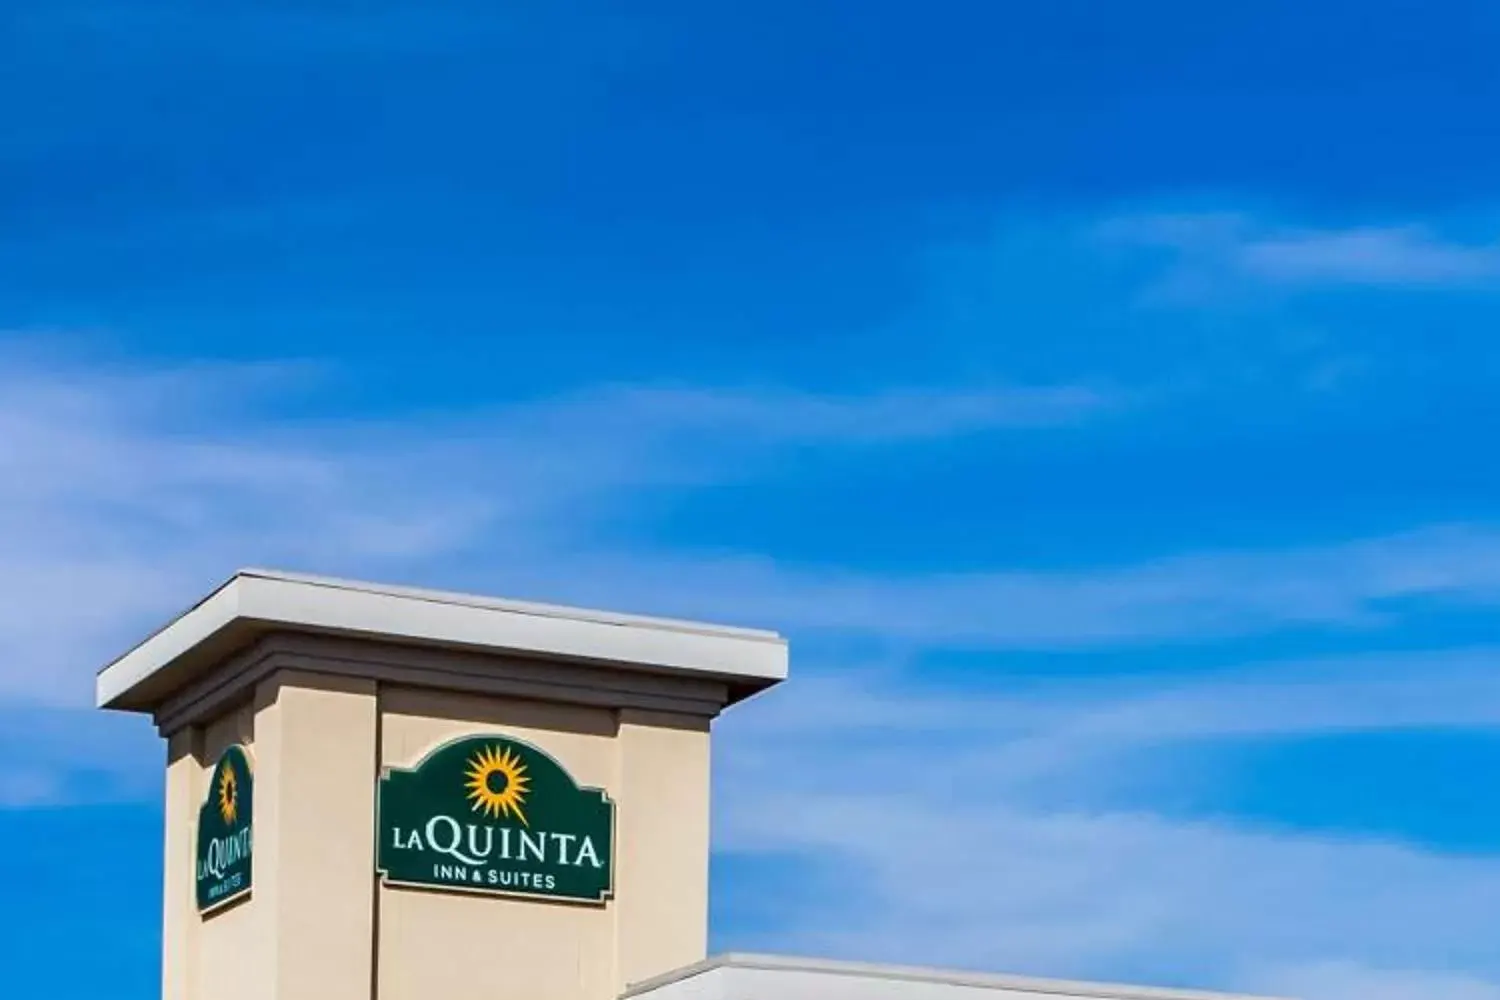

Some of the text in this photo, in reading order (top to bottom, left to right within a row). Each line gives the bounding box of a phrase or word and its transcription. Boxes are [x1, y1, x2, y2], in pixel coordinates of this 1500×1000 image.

[392, 815, 602, 868] LA QUINTA
[433, 863, 556, 889] INN & SUITES
